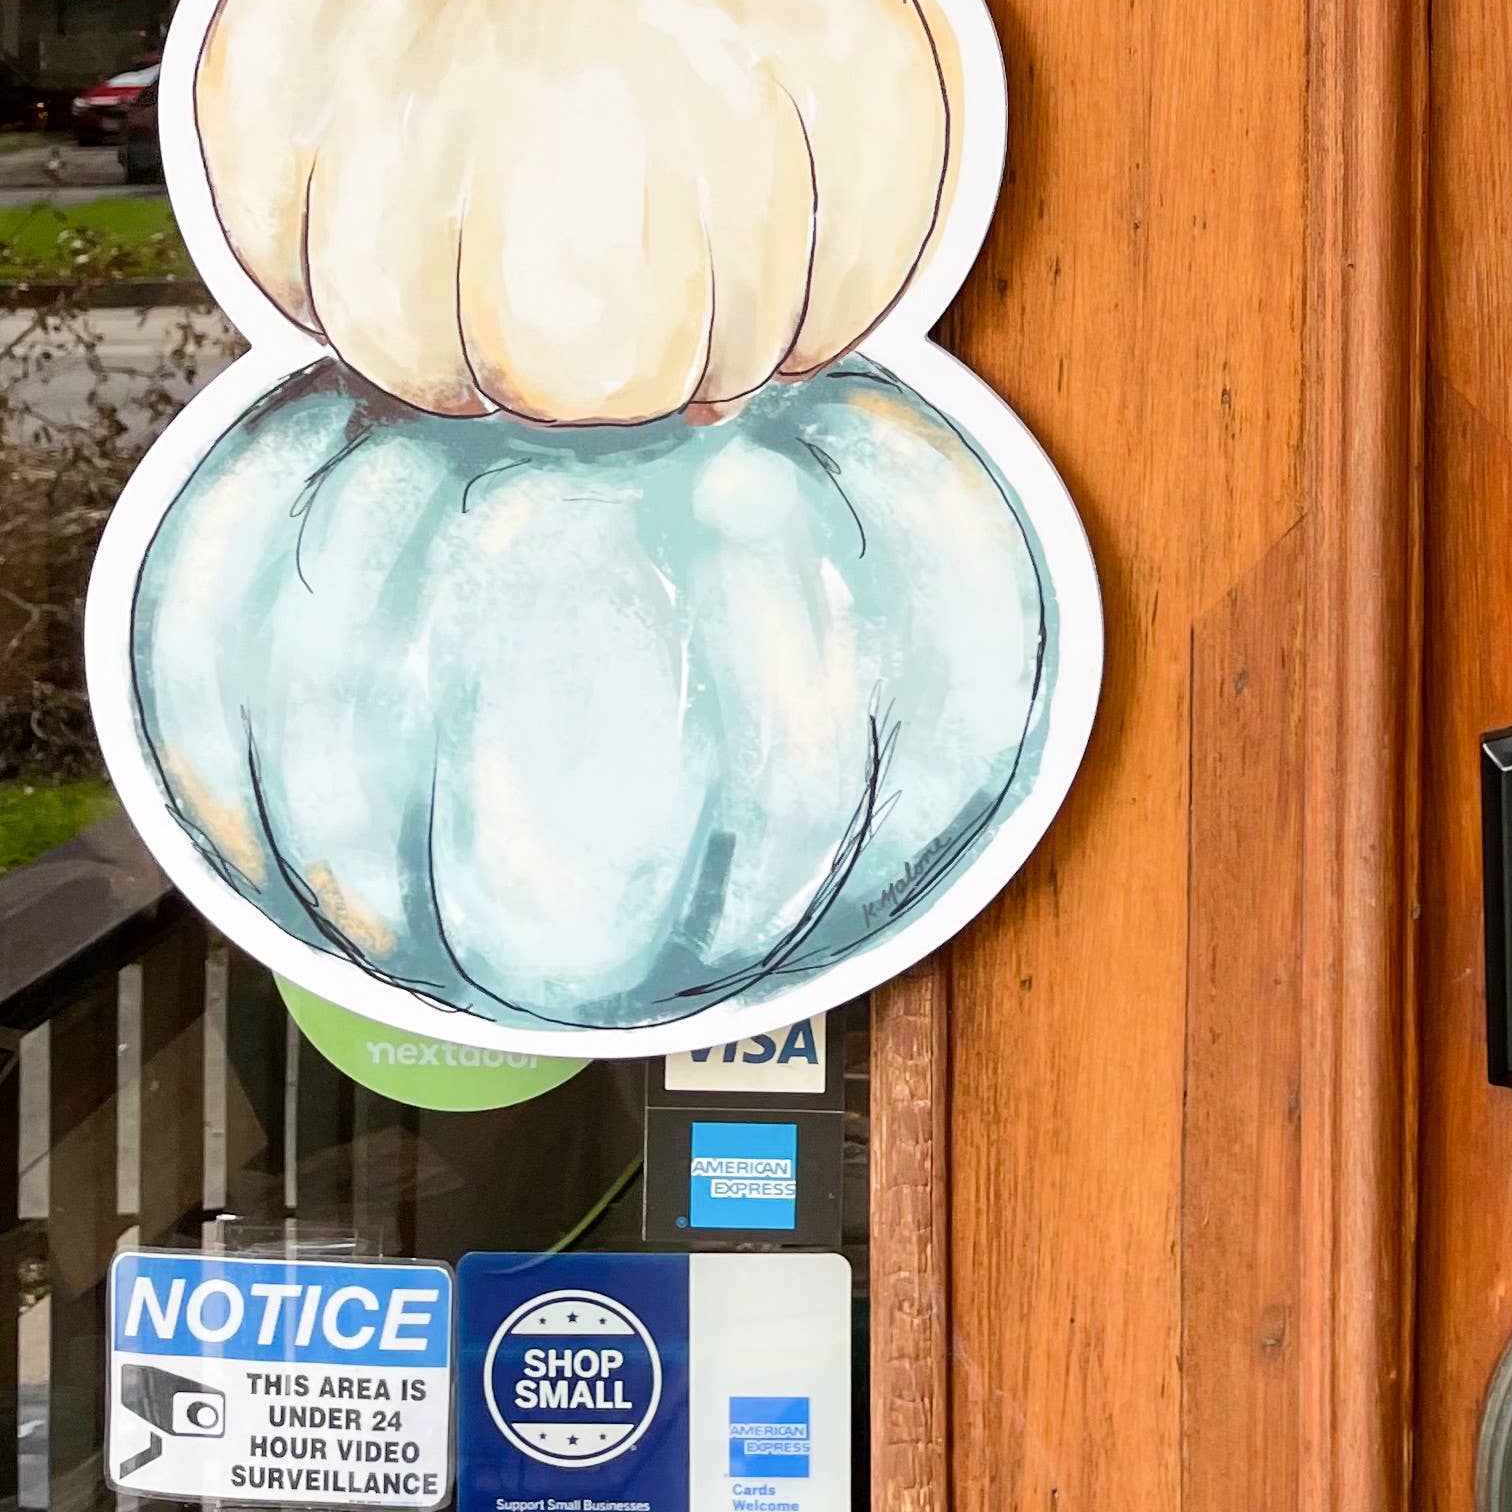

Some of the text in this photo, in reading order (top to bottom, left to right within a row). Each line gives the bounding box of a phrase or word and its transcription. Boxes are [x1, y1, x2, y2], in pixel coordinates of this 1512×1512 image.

[692, 1160, 788, 1175] AMERICAN
[714, 1182, 796, 1196] EXPRESS
[124, 1276, 439, 1351] NOTICE
[523, 1348, 624, 1378] SHOP
[247, 1372, 426, 1402] THIS AREA IS
[514, 1380, 632, 1410] SMALL
[269, 1406, 402, 1432] UNDER 24
[730, 1425, 804, 1436] AMERICAN
[250, 1435, 420, 1464] HOUR VIDEO
[746, 1442, 810, 1453] EXPRESS
[231, 1464, 438, 1496] SURVEILLANCE
[732, 1483, 776, 1496] Cards
[496, 1498, 650, 1512] Support Small Businesses
[732, 1499, 800, 1512] Welcome
